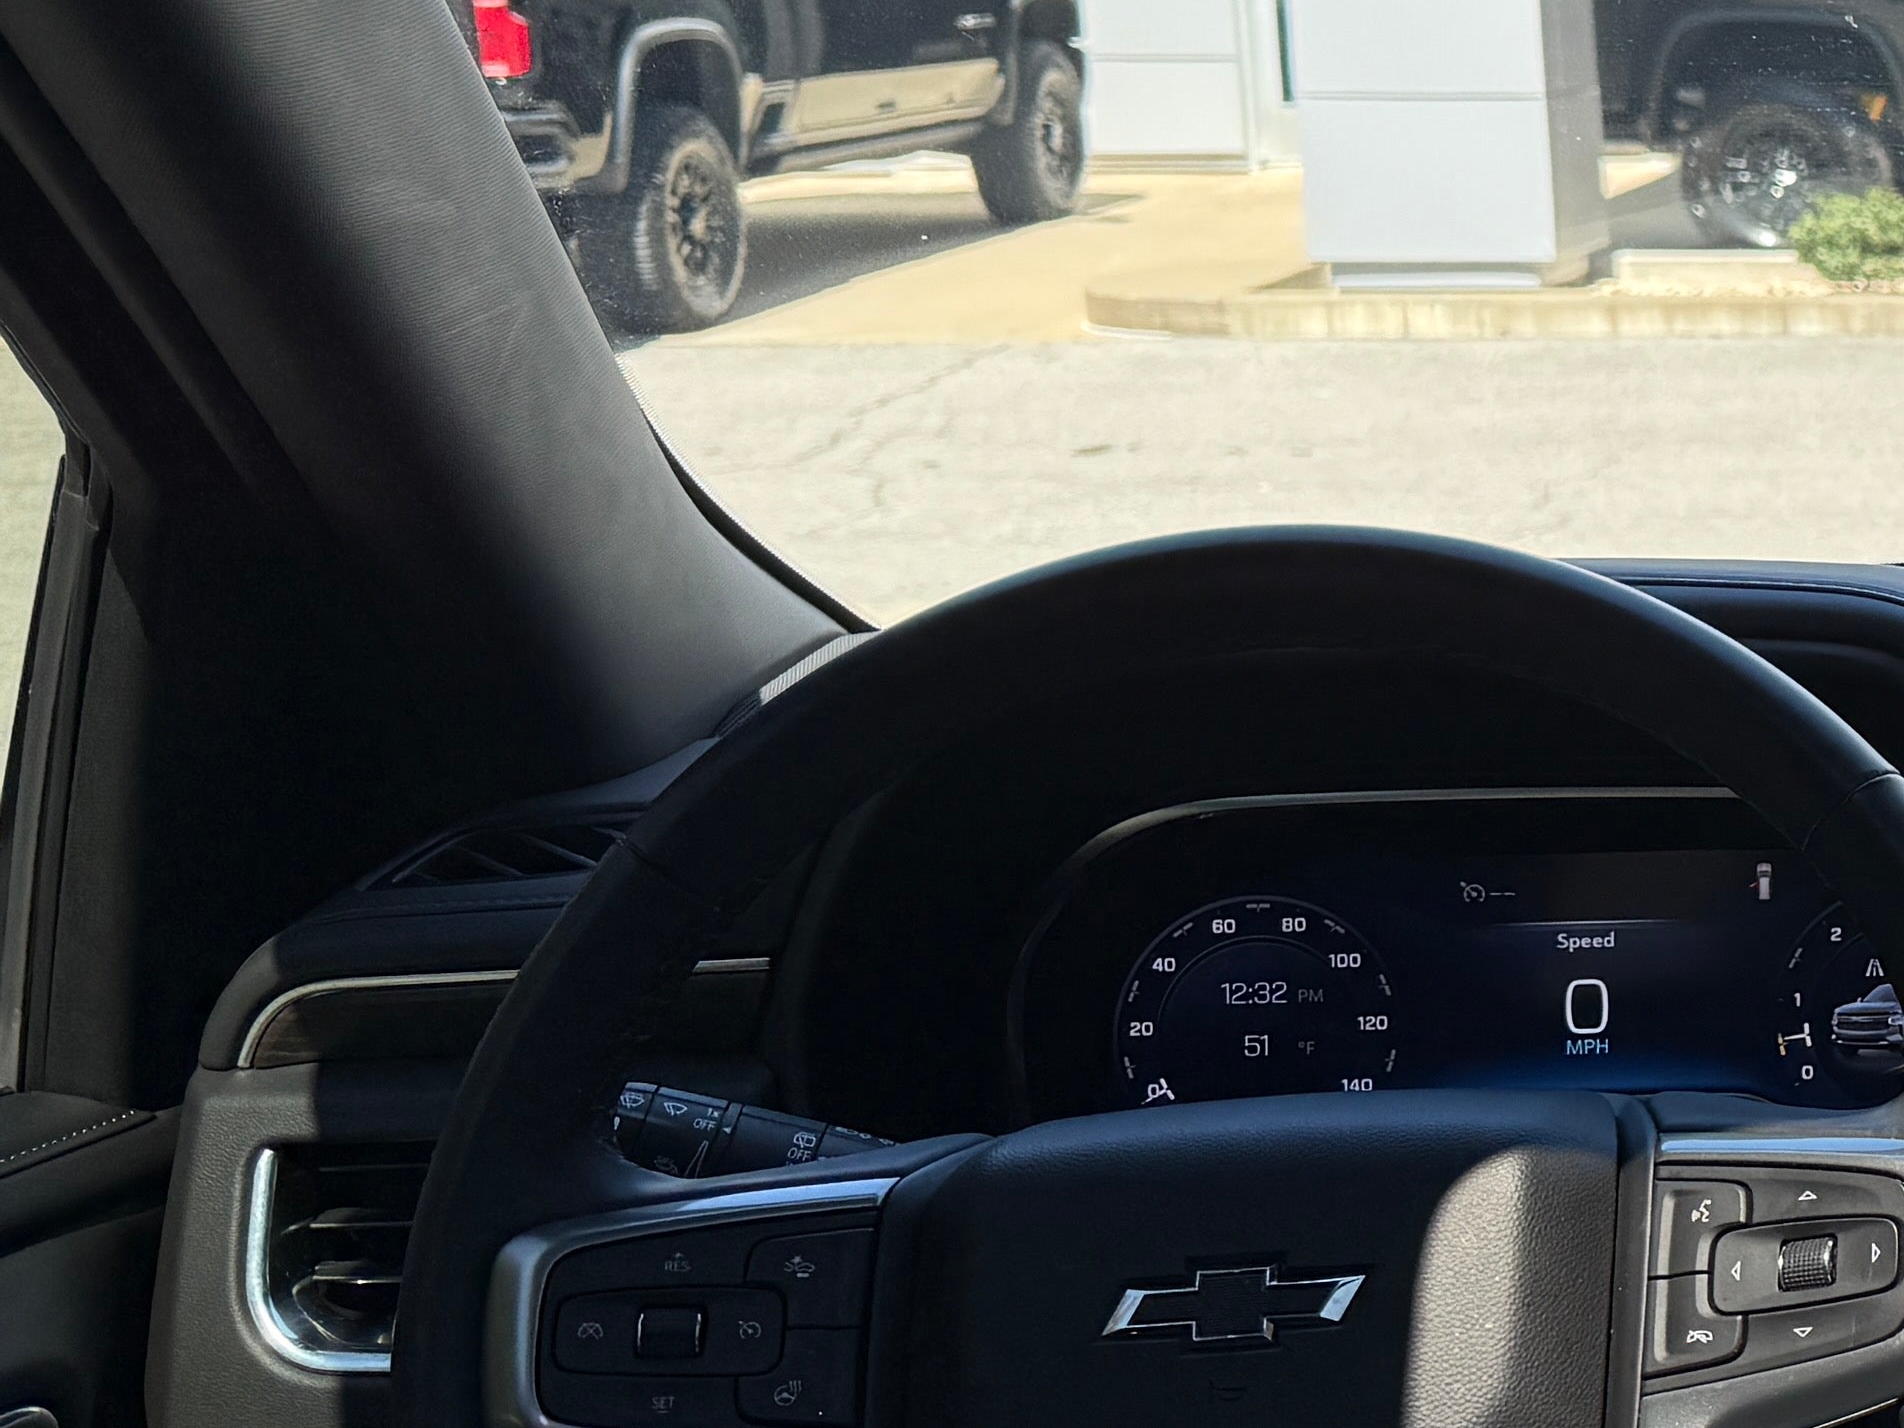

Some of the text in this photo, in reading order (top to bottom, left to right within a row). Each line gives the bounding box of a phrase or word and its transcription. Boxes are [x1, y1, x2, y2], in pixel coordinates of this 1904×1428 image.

[1212, 917, 1236, 934] 60
[1281, 917, 1306, 934] 80
[1555, 931, 1616, 953] Speed
[1830, 927, 1843, 942] 2
[1151, 956, 1177, 974] 40
[1327, 952, 1362, 970] 100
[1220, 981, 1324, 1007] 12:32 PM
[1793, 992, 1802, 1007] 1
[1564, 978, 1609, 1034] 0
[1129, 1020, 1155, 1038] 20
[1357, 1014, 1389, 1032] 120
[1244, 1034, 1316, 1058] 51 °F
[1566, 1038, 1609, 1056] MPH
[1800, 1064, 1815, 1081] 0
[1341, 1077, 1373, 1093] 140
[693, 1117, 717, 1130] OFF
[787, 1147, 812, 1161] OFF
[651, 1396, 676, 1410] SET
